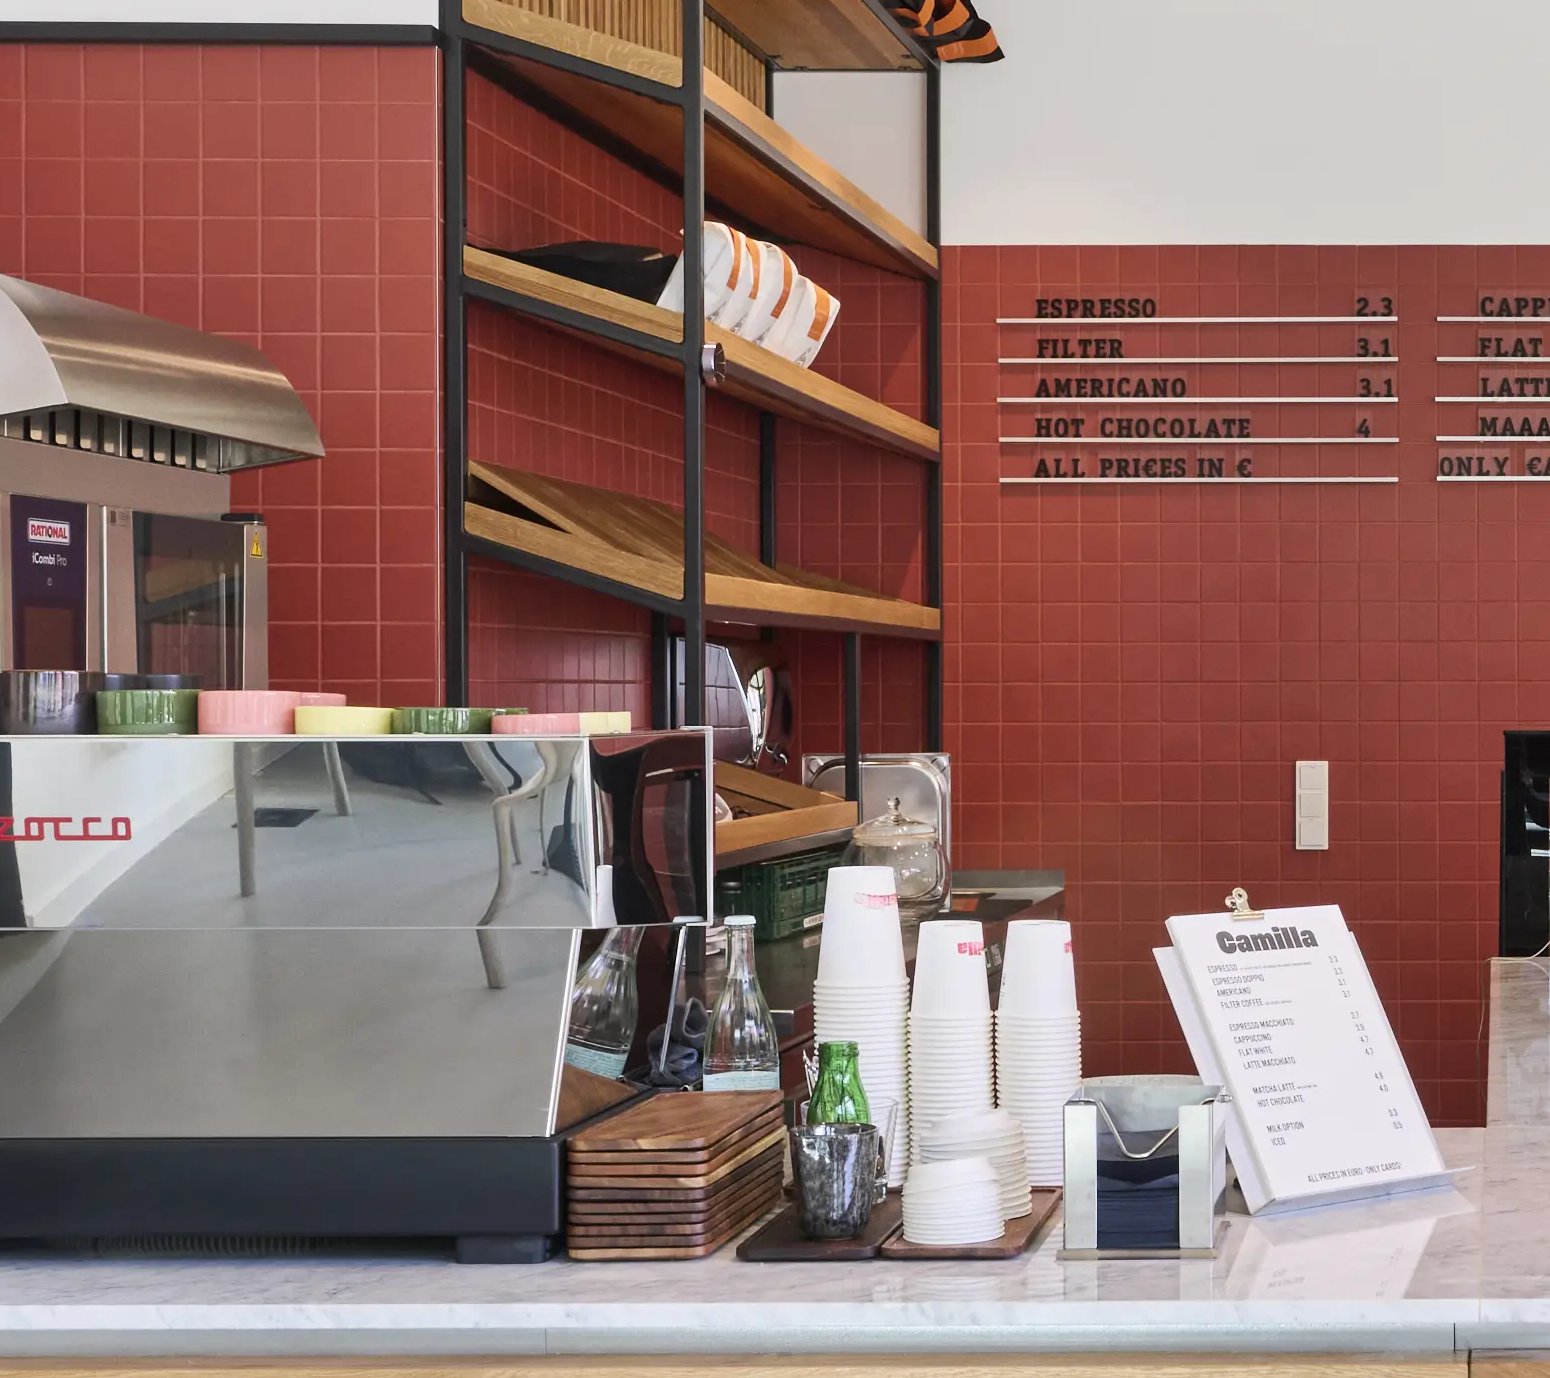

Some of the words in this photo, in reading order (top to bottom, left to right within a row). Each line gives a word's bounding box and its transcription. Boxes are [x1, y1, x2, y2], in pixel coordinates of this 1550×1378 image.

[1035, 298, 1156, 319] ESPRESSO
[1356, 297, 1394, 317] 2.3
[1037, 338, 1125, 359] FILTER
[1356, 338, 1393, 358] 3.1
[1478, 337, 1542, 357] FLAT
[1035, 378, 1187, 398] AMERICANO
[1359, 378, 1394, 398] 3.1
[1035, 418, 1085, 438] HOT
[1100, 418, 1251, 438] CHOCOLATE
[1356, 419, 1371, 438] 4
[1035, 458, 1085, 478] ALL
[1099, 458, 1186, 478] PRI€ES
[1197, 458, 1224, 478] IN
[1236, 458, 1253, 478] €
[1439, 456, 1510, 477] ONLY
[31, 524, 68, 539] RATIONAL
[32, 552, 56, 566] iCombi
[1215, 926, 1319, 954] Camilla
[1207, 964, 1238, 974] ESPRESSO
[1212, 976, 1243, 986] ESPRESSO
[1243, 974, 1265, 984] DOPPIO
[1216, 986, 1251, 997] AMERICANO
[1220, 1000, 1241, 1010] FILTER
[1241, 998, 1264, 1008] COFFEE
[1229, 1021, 1259, 1031] ESPRESSO
[1259, 1018, 1295, 1028] MACCHIATO
[1233, 1033, 1272, 1044] CAPPUCCINO
[1238, 1048, 1253, 1057] FLAT
[1253, 1046, 1273, 1055] WHITE
[1243, 1060, 1261, 1070] LATTE
[1261, 1056, 1296, 1067] MACCHIATO
[1252, 1085, 1278, 1094] MATCHA
[1278, 1082, 1296, 1092] LATTE
[1256, 1098, 1270, 1108] HOT
[1270, 1094, 1305, 1106] CHOCOLATE
[1266, 1124, 1282, 1133] MILK
[1282, 1121, 1305, 1131] OPTION
[1271, 1137, 1286, 1146] ICED
[1307, 1174, 1319, 1183] ALL
[1319, 1170, 1341, 1181] PRICES
[1340, 1169, 1347, 1178] IN
[1347, 1167, 1364, 1177] EURO
[1365, 1165, 1381, 1174] ONLY
